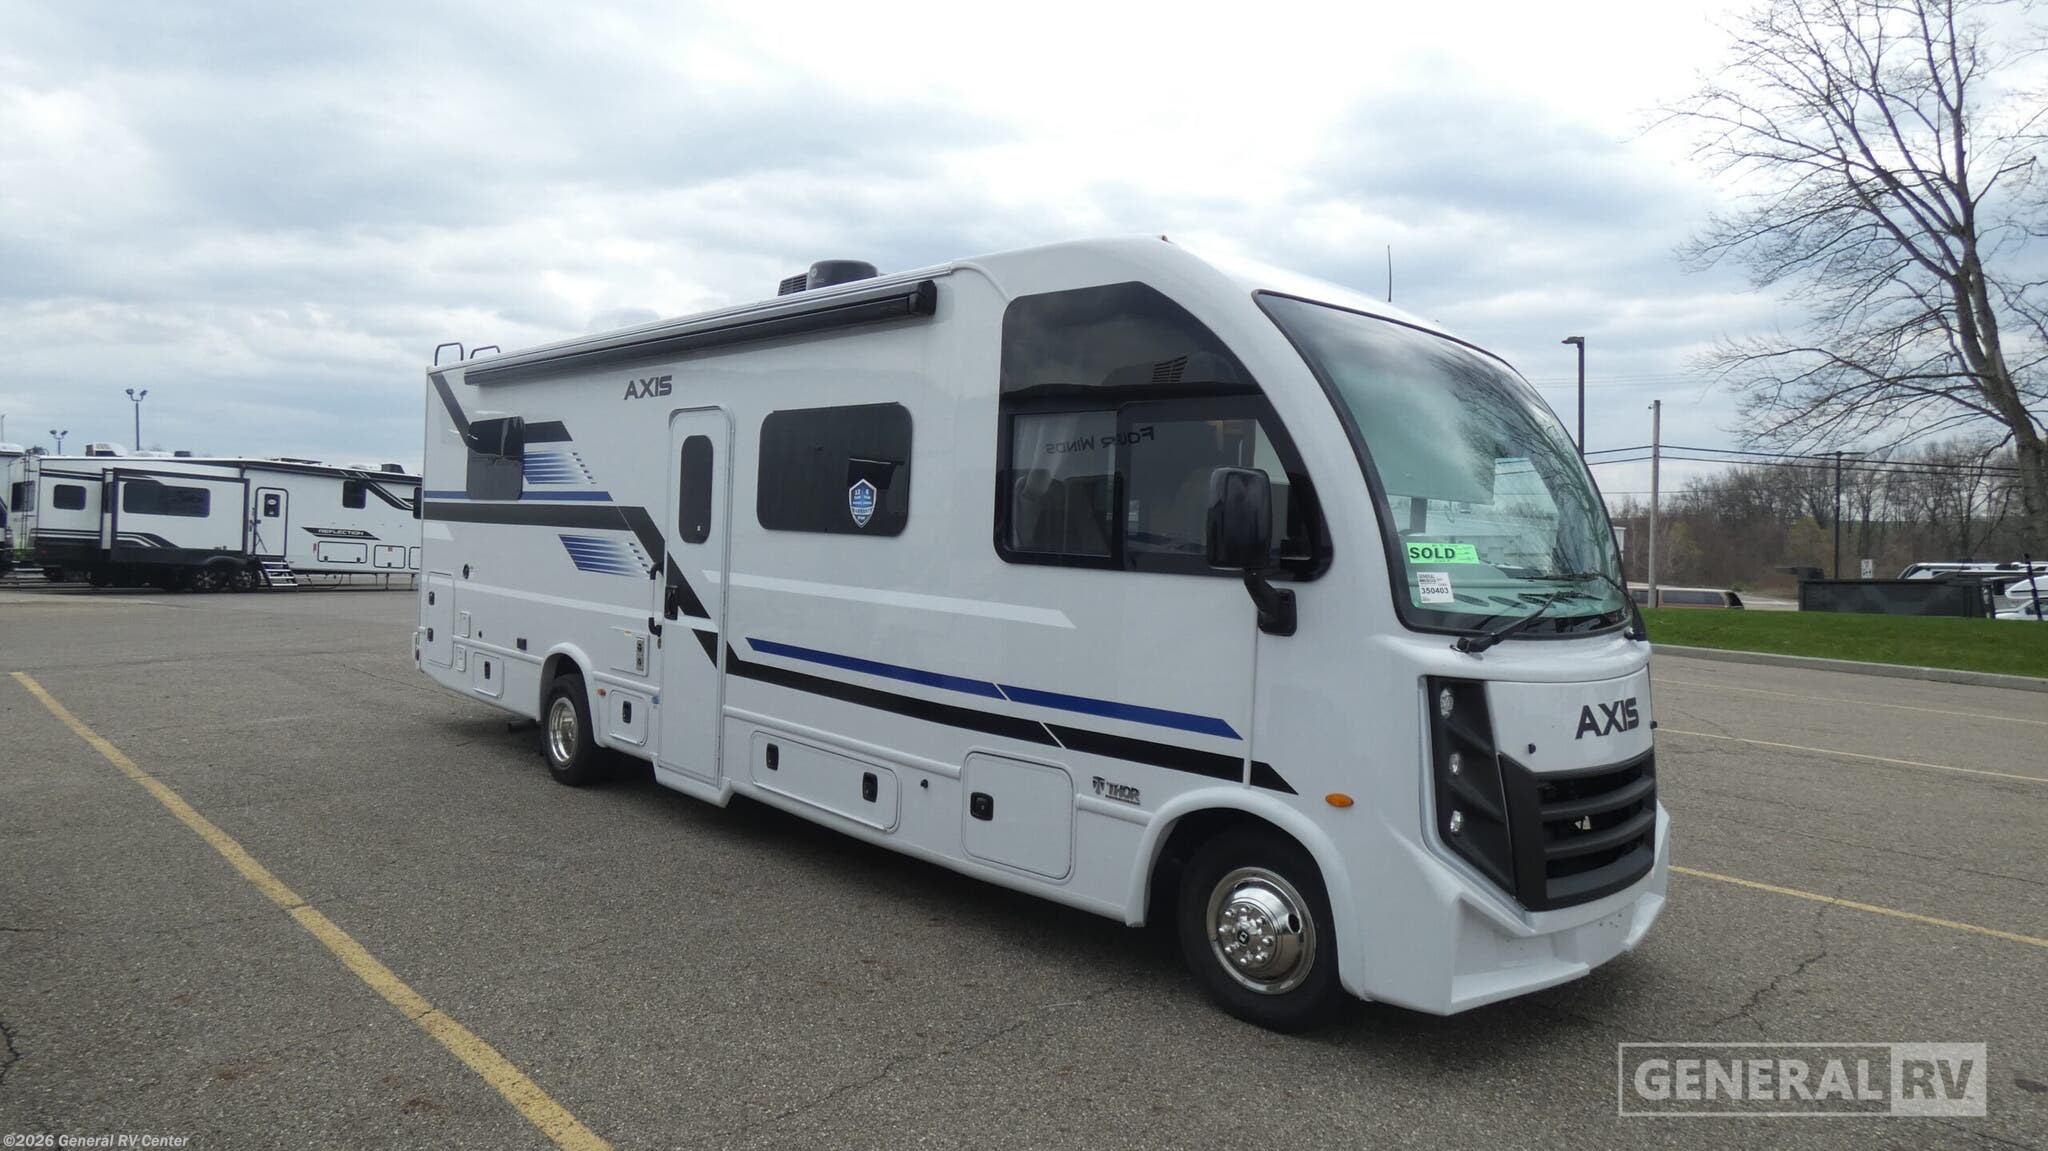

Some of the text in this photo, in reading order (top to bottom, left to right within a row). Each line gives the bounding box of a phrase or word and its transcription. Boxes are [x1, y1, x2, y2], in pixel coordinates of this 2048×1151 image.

[624, 375, 672, 400] AXIS
[1409, 547, 1455, 559] SOLD
[1575, 697, 1639, 739] AXIS
[1105, 781, 1141, 801] THOR
